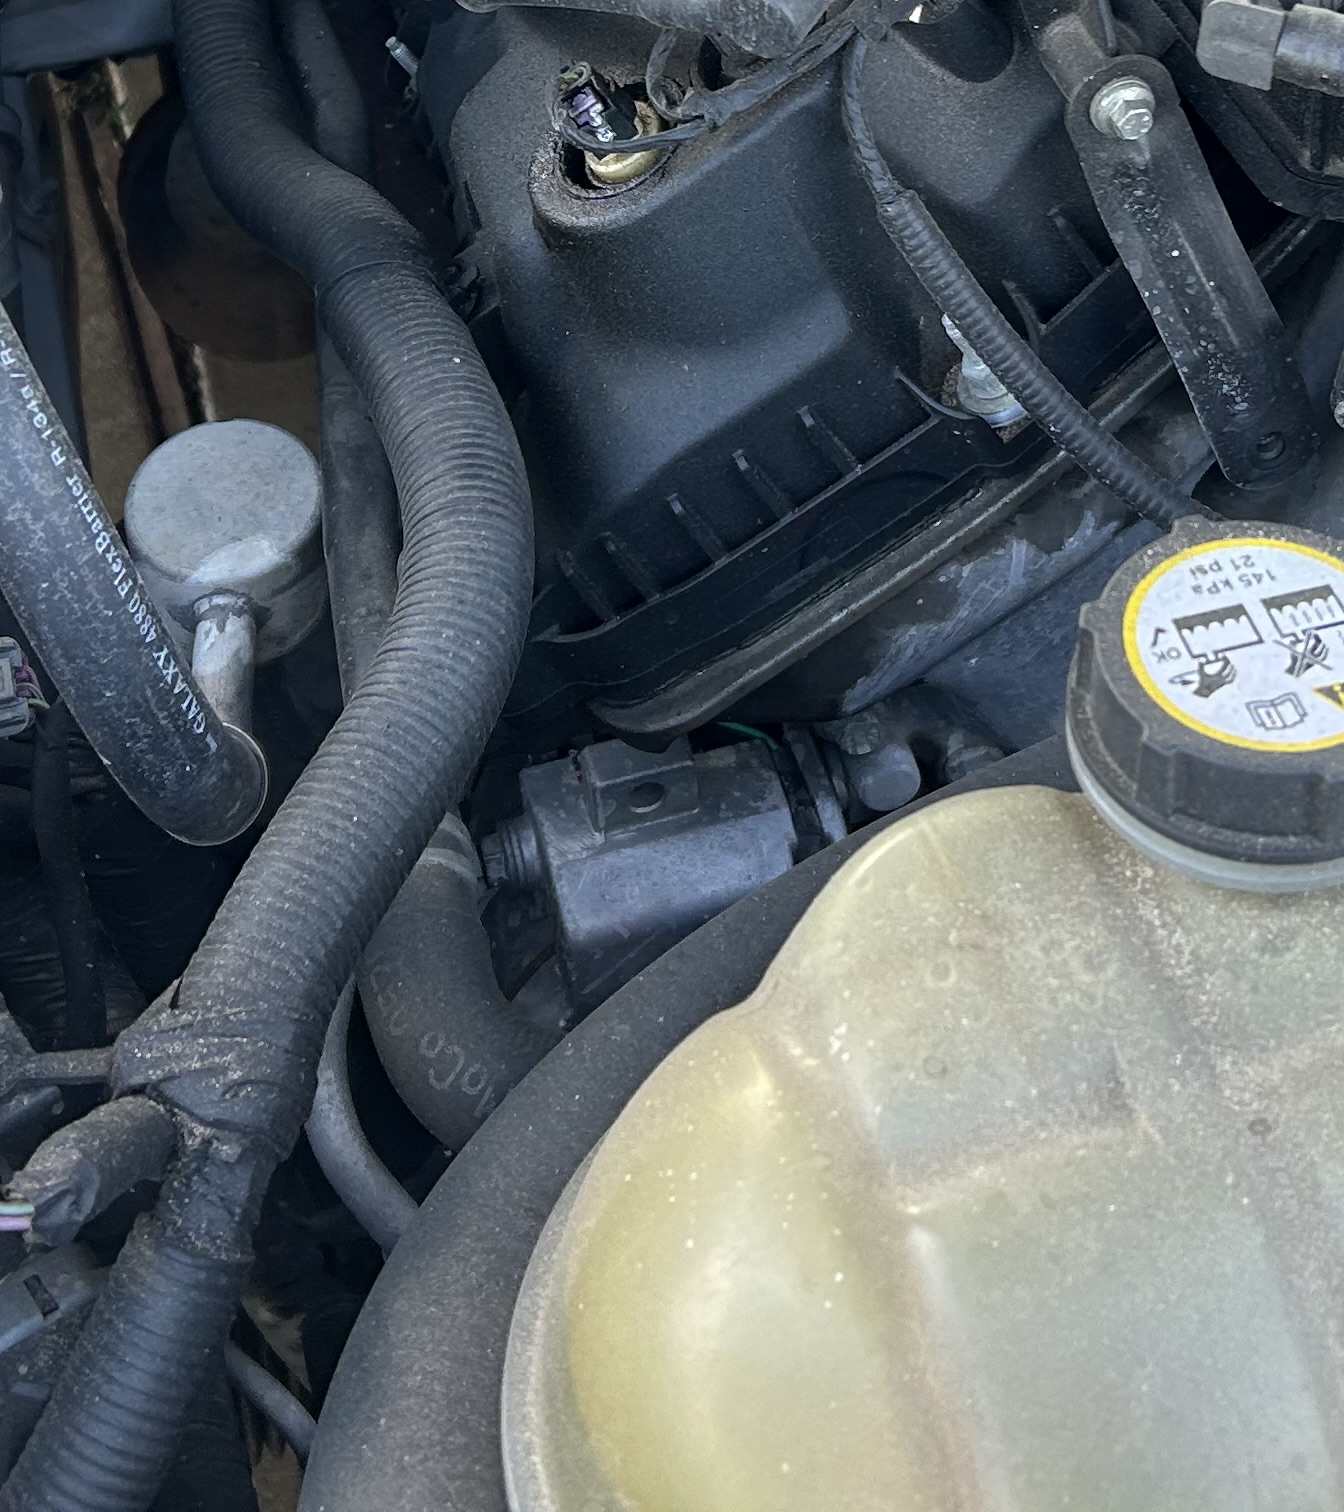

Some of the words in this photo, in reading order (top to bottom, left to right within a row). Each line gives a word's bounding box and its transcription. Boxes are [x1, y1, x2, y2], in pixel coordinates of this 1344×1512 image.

[19, 387, 66, 468] R-134a
[66, 472, 131, 599] FlexBarrier
[1189, 558, 1223, 581] psi
[1230, 554, 1256, 572] 21
[1192, 577, 1234, 595] kPa
[1238, 568, 1278, 588] 145
[1152, 647, 1182, 663] OK
[152, 646, 207, 736] GALAXY
